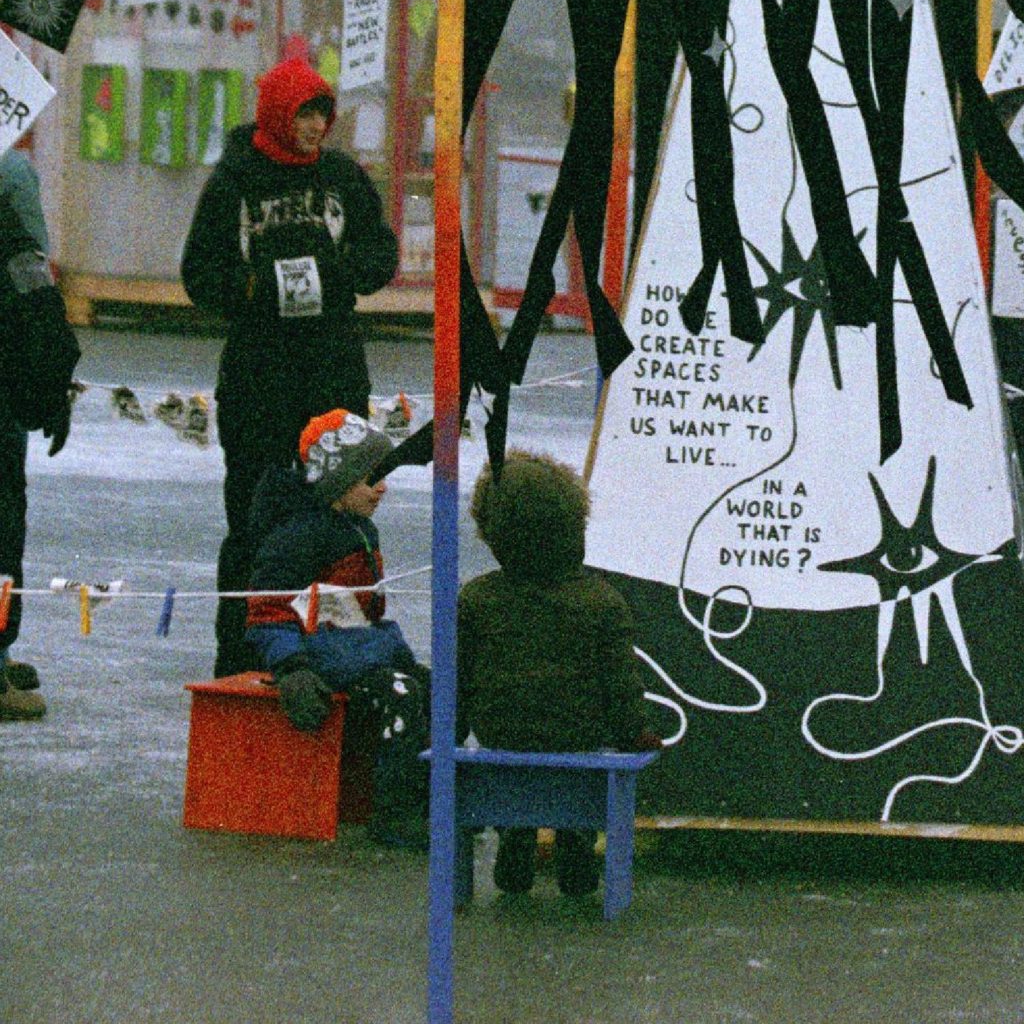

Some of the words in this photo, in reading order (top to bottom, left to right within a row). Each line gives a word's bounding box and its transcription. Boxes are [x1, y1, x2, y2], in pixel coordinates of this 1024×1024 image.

[640, 307, 668, 328] DO
[706, 310, 717, 330] E
[640, 334, 725, 358] CREATE
[634, 358, 721, 383] SPACES
[632, 389, 690, 409] THAT
[703, 391, 769, 414] MAKE
[631, 417, 656, 436] US
[670, 420, 728, 438] WANT
[747, 425, 773, 443] TO
[666, 446, 737, 468] LIVE...
[762, 479, 783, 495] IN
[793, 480, 808, 497] A
[726, 497, 803, 519] WORLD
[738, 522, 793, 543] THAT
[805, 527, 821, 544] IS
